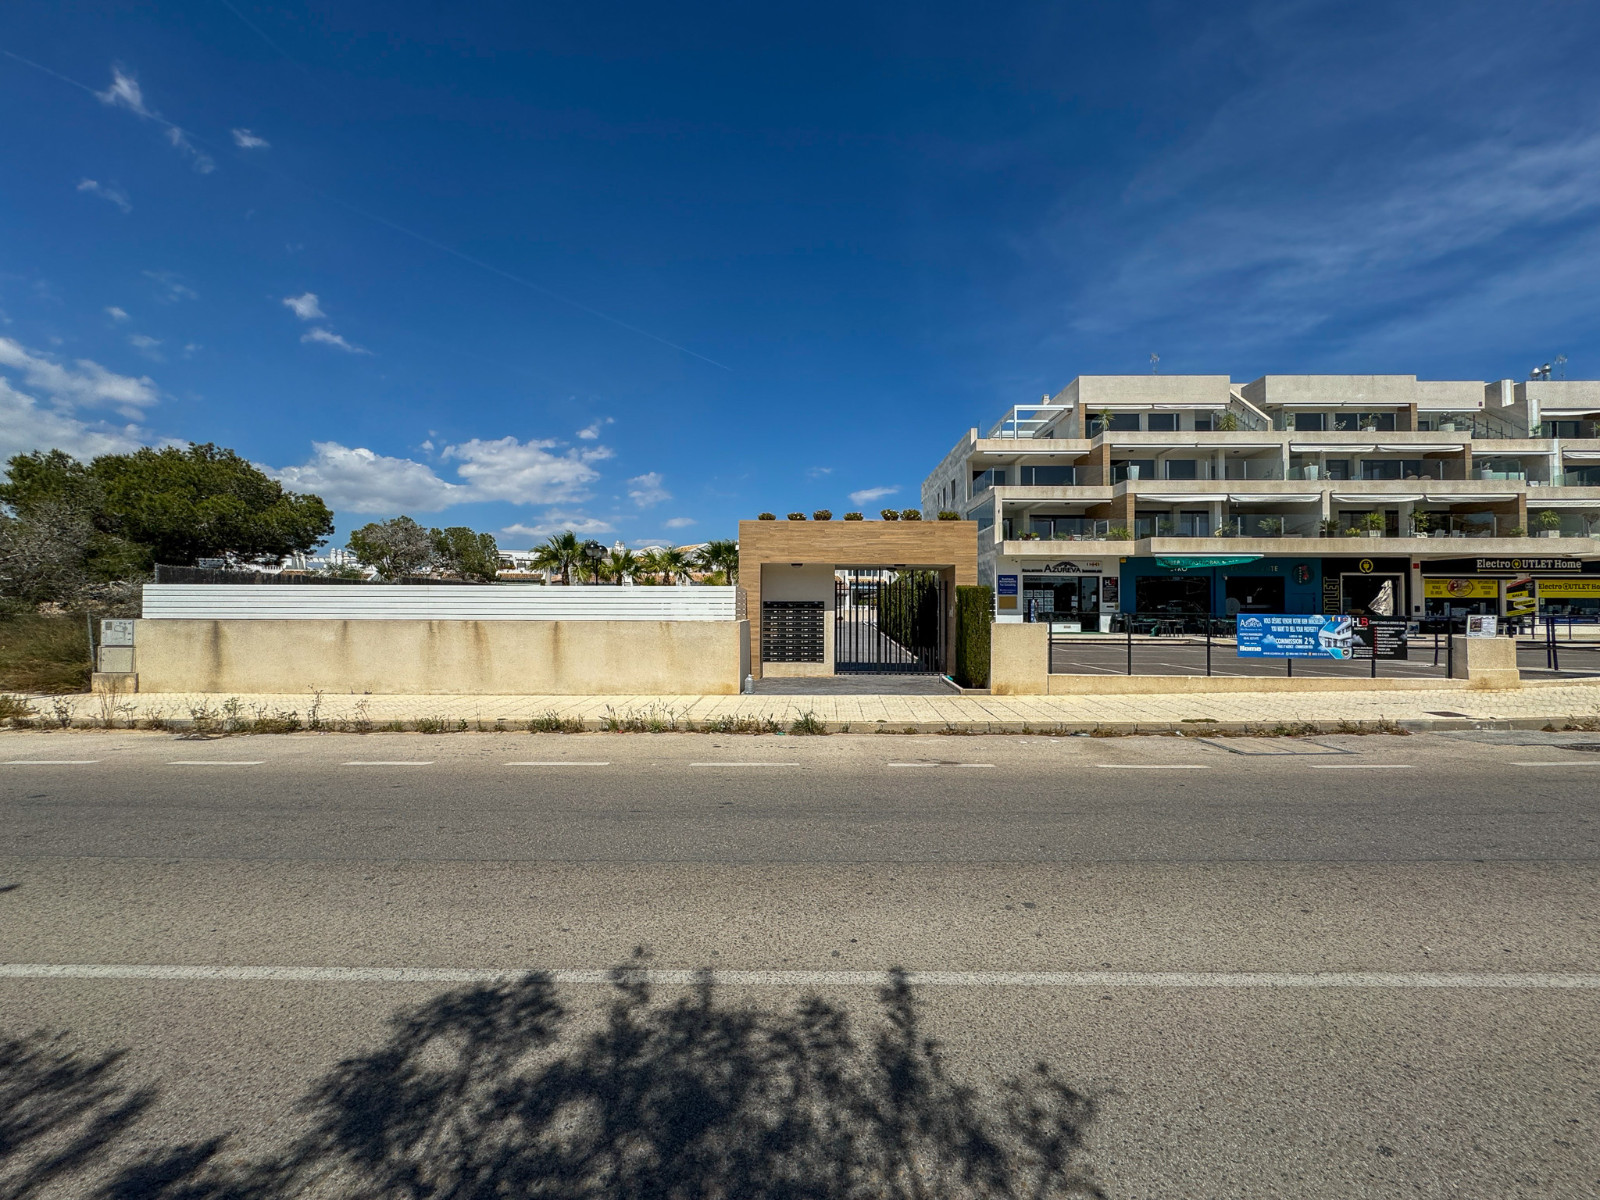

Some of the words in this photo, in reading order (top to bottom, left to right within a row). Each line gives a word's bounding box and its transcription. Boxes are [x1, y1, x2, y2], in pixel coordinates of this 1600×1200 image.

[1477, 559, 1510, 568] Electro
[1554, 560, 1582, 569] Home
[1352, 617, 1369, 627] HLB
